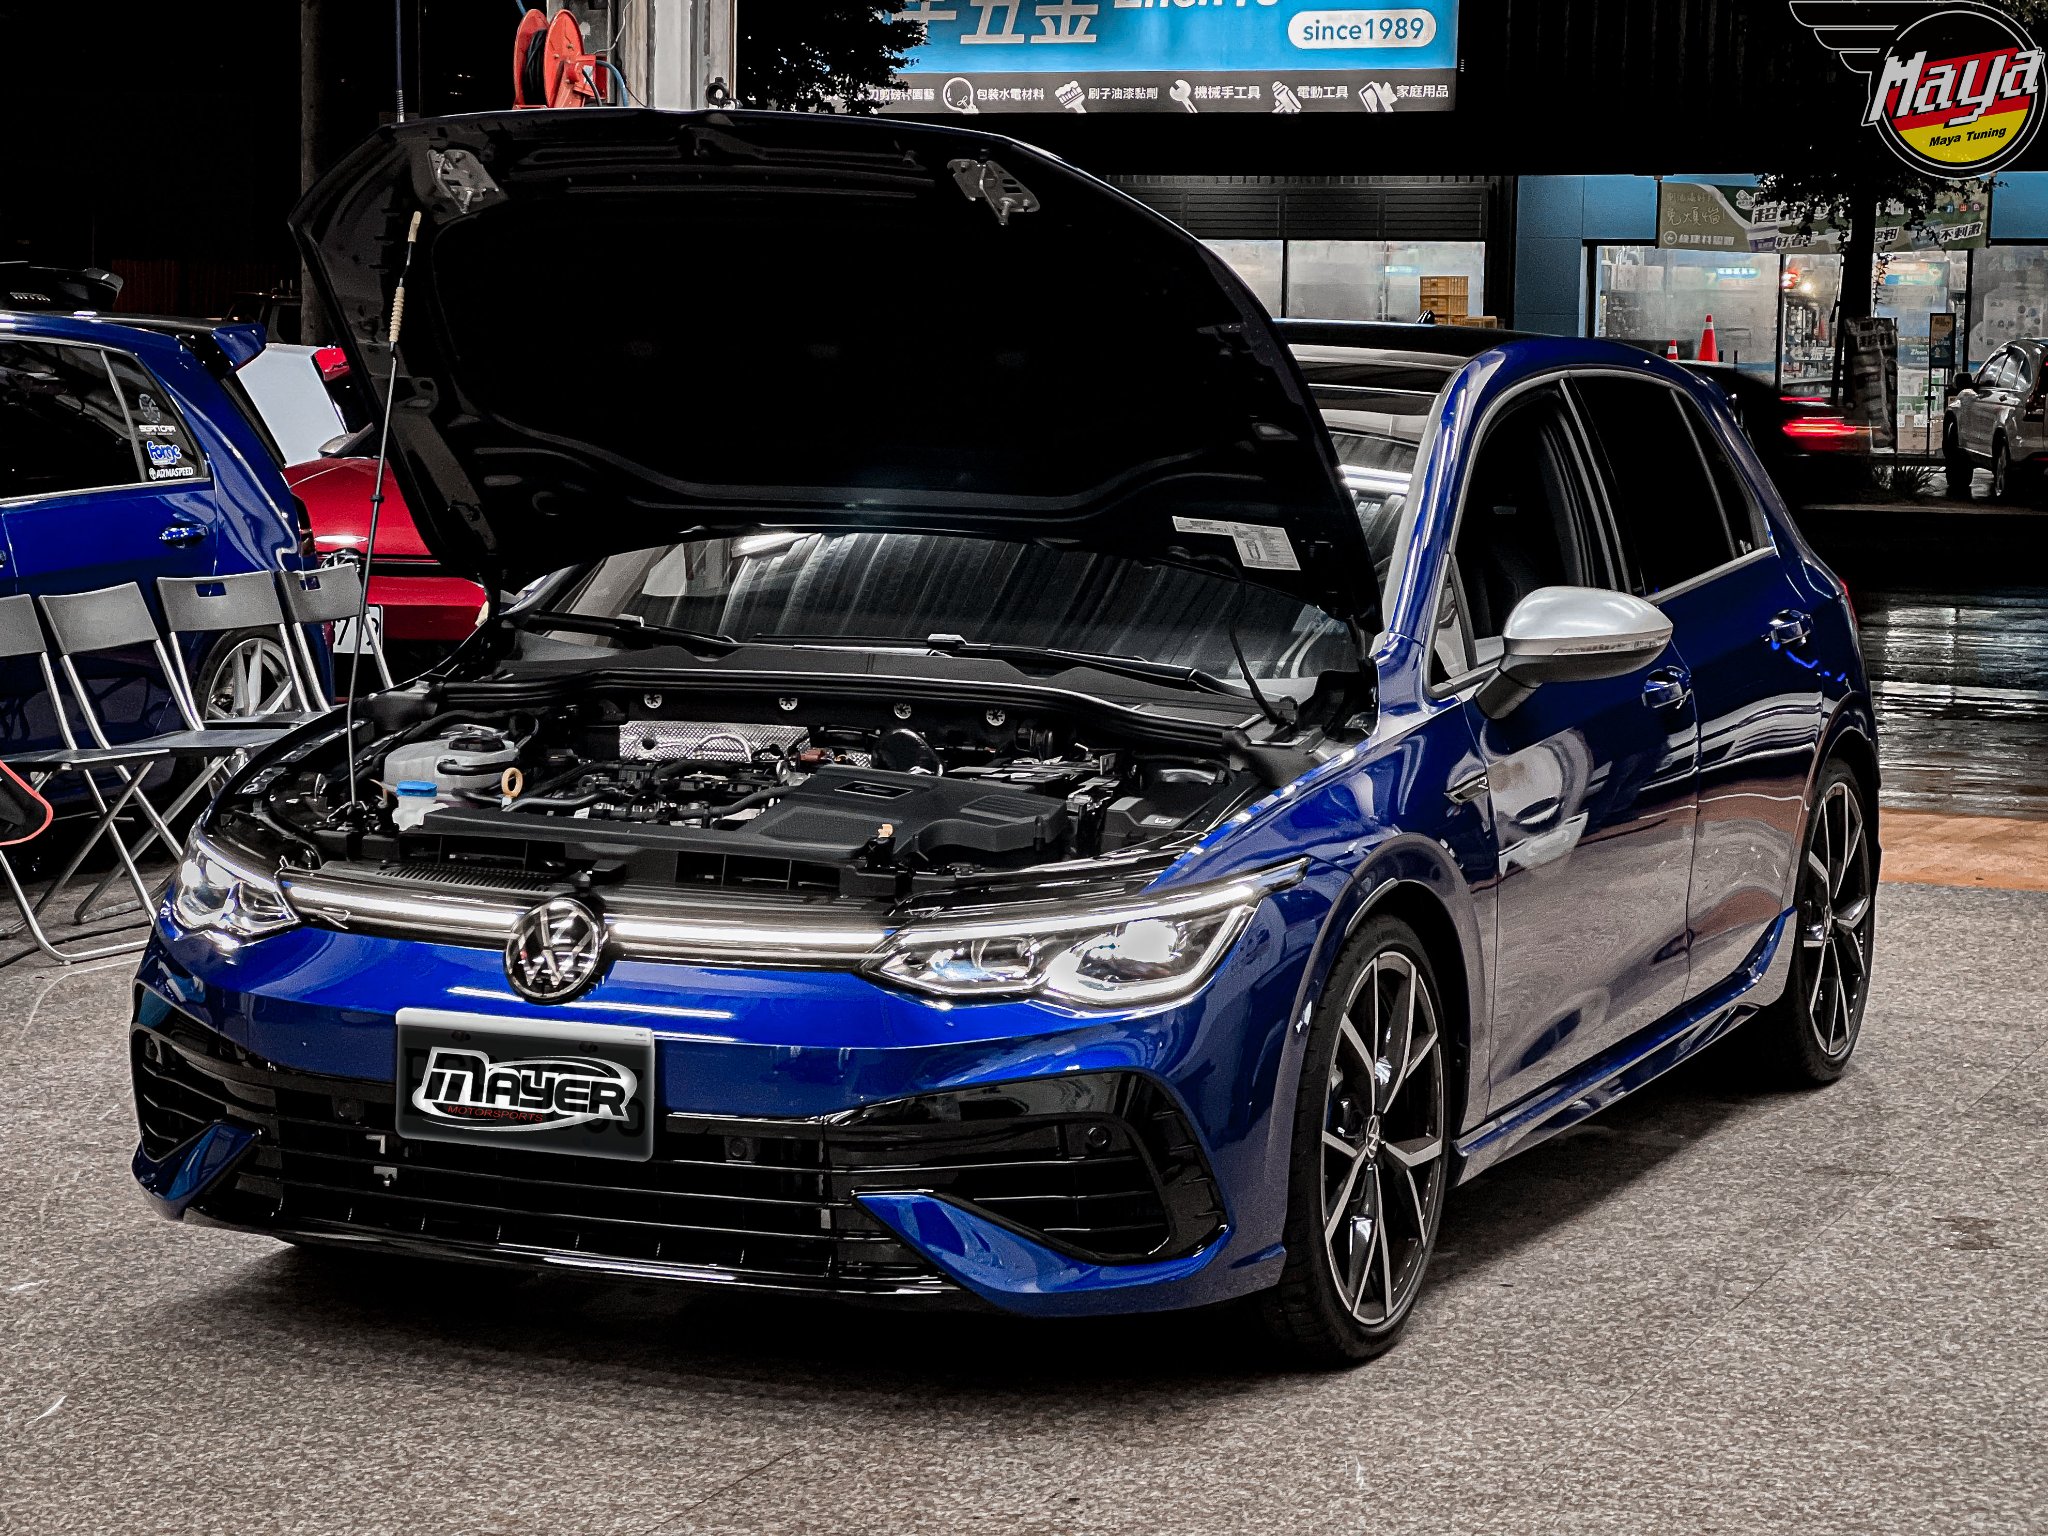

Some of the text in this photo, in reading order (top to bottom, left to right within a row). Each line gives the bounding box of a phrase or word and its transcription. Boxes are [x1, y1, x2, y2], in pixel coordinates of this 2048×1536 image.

[1303, 17, 1424, 41] since1989
[976, 88, 1045, 100] 包裝水電材料
[1194, 86, 1261, 99] 機械手工具
[1297, 86, 1349, 99] 電動工具
[1396, 85, 1449, 98] 家庭用品
